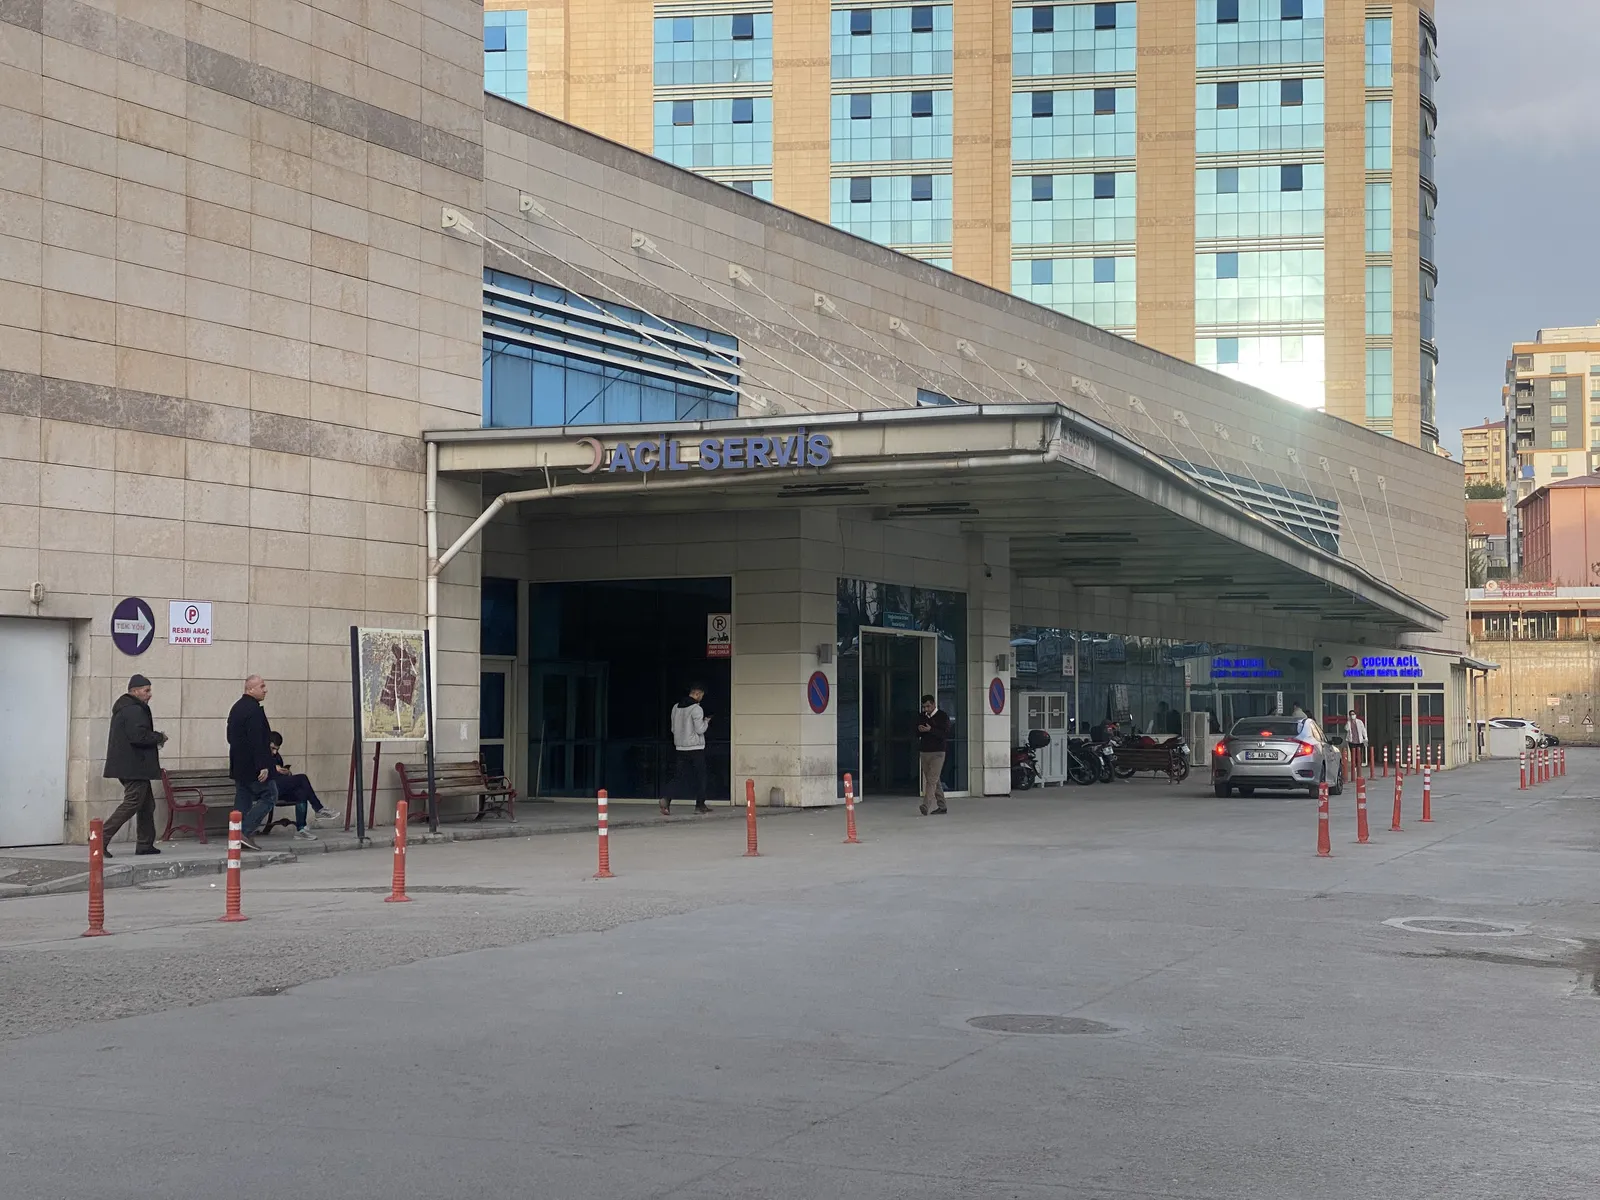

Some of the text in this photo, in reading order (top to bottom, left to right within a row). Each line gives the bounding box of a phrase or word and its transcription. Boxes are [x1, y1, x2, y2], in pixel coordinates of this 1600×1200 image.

[608, 426, 832, 473] ACİL SERVİS
[132, 623, 145, 631] YÖN
[1362, 655, 1419, 668] ÇOCUK ACİL
